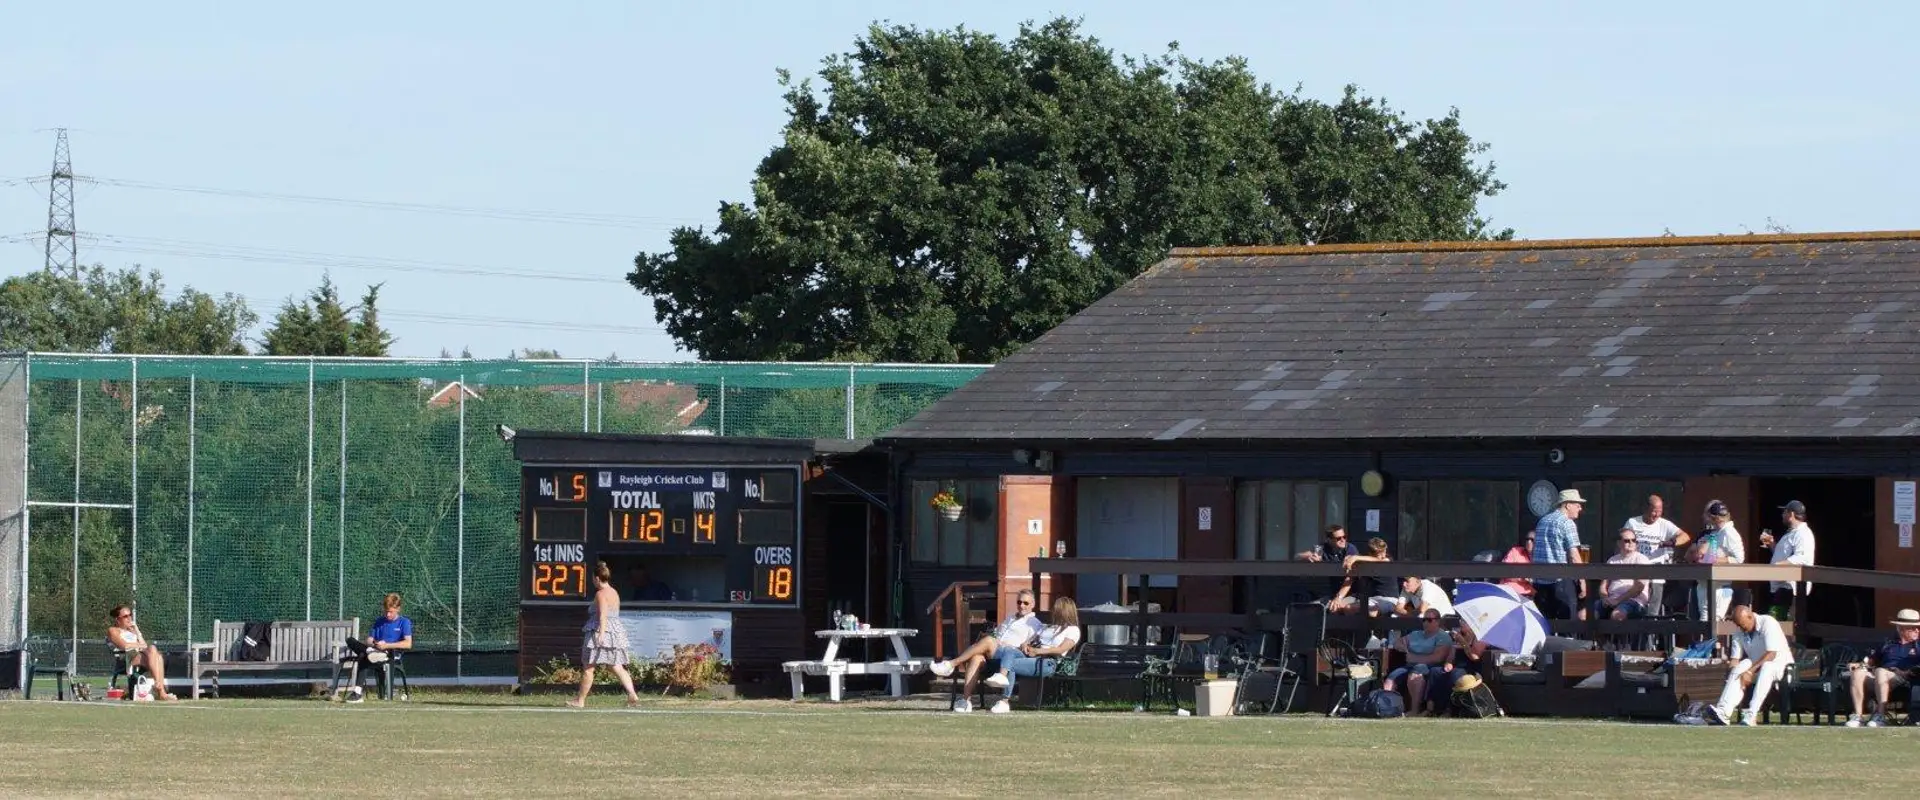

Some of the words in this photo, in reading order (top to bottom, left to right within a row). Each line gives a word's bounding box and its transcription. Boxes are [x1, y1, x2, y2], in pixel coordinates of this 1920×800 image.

[540, 478, 555, 496] No.
[573, 474, 585, 500] 5
[619, 475, 652, 486] Rayleigh
[654, 475, 683, 484] Cricket
[685, 475, 704, 484] Club
[744, 479, 760, 498] No.
[611, 491, 661, 508] TOTAL
[692, 491, 716, 509] WKTS
[623, 511, 662, 542] 112
[698, 512, 714, 540] 4
[534, 544, 552, 562] 1st
[554, 544, 584, 562] INNS
[754, 547, 792, 564] OVERS
[536, 565, 584, 595] 227
[768, 567, 792, 598] 18
[730, 590, 752, 601] ESU
